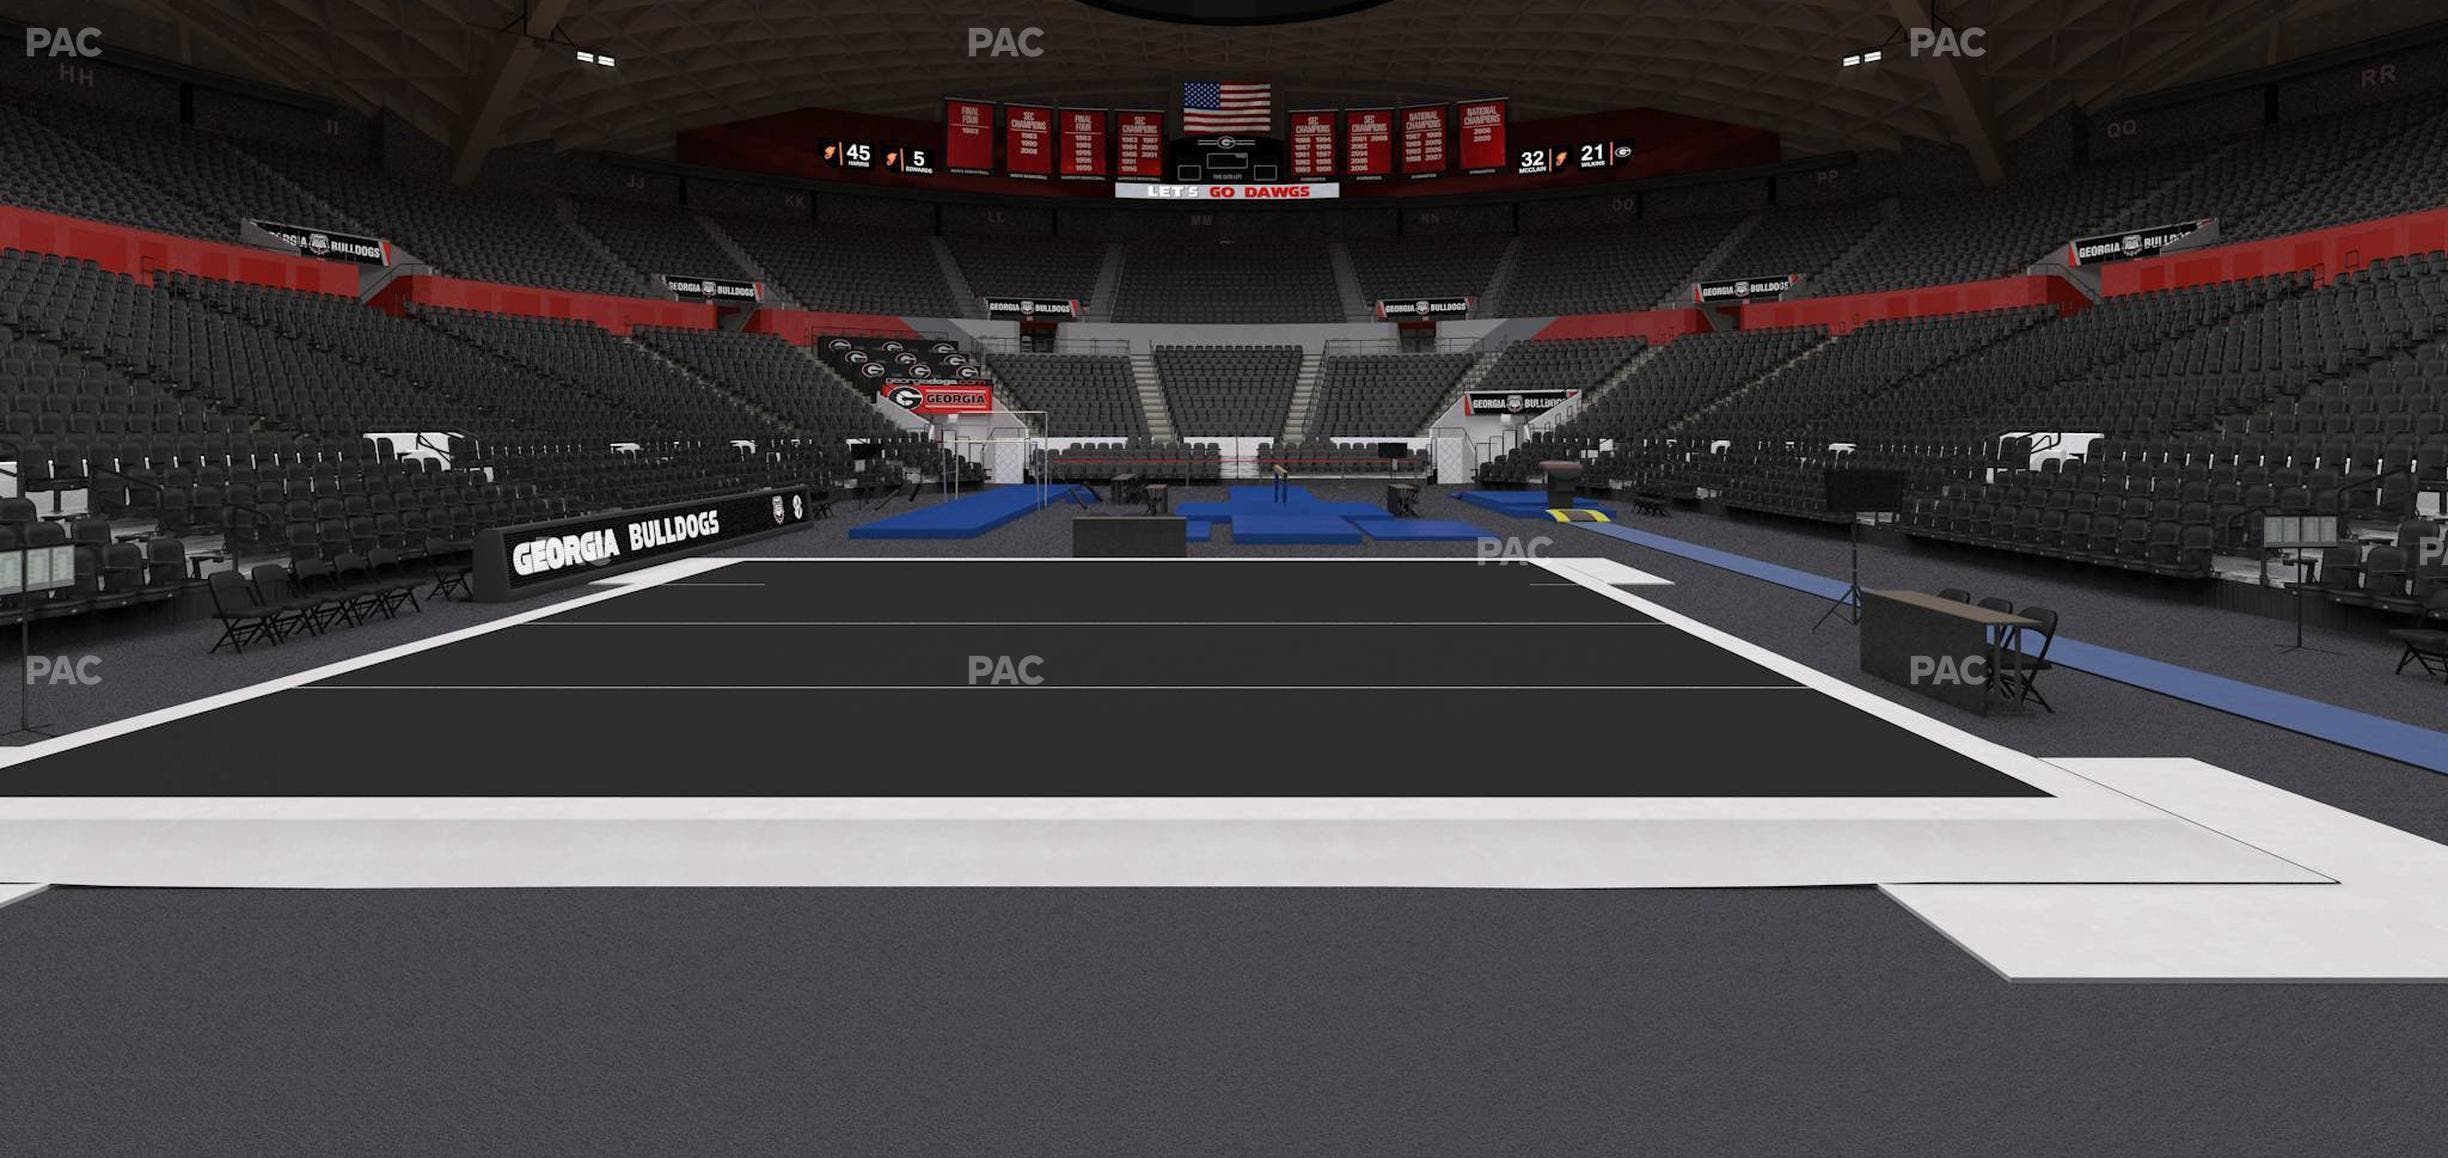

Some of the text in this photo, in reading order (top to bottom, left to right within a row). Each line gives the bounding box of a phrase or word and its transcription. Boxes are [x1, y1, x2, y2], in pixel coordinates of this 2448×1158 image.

[59, 62, 93, 87] HH
[2361, 64, 2396, 88] RR
[962, 106, 979, 115] FINAL
[1467, 106, 1497, 116] NATIONAL
[963, 115, 979, 124] FOUR
[1023, 112, 1035, 120] SEC
[1075, 115, 1092, 123] FINAL
[1134, 116, 1146, 125] SEC
[1308, 116, 1319, 125] SEC
[1364, 115, 1376, 124] SEC
[1408, 111, 1438, 121] NATIONAL
[1463, 114, 1501, 125] CHAMPIONS
[1011, 119, 1047, 130] CHAMPIONS
[1075, 123, 1092, 131] FOUR
[1122, 125, 1158, 134] CHAMPIONS
[1295, 125, 1331, 134] CHAMPIONS
[1351, 124, 1387, 133] CHAMPIONS
[1406, 120, 1441, 130] CHAMPIONS
[2107, 120, 2137, 137] QQ
[847, 144, 871, 161] 45
[1581, 144, 1603, 161] 21
[914, 151, 925, 166] 5
[1521, 151, 1544, 167] 32
[905, 166, 933, 174] EDWARDS
[1148, 186, 1309, 197] LET'S GO DAWGS
[331, 241, 380, 258] BULLDOGS
[2079, 242, 2120, 258] GEORGIA
[717, 285, 754, 297] BULLDOGS
[1703, 286, 1734, 297] GEORGIA
[989, 303, 1071, 313] GEORGIA BULLDOGS
[1385, 303, 1466, 313] GEORGIA BULLDOGS
[927, 394, 985, 404] GEORGIA
[1473, 400, 1506, 409] GEORGIA
[513, 510, 720, 575] GEORGIA BULLDOGS
